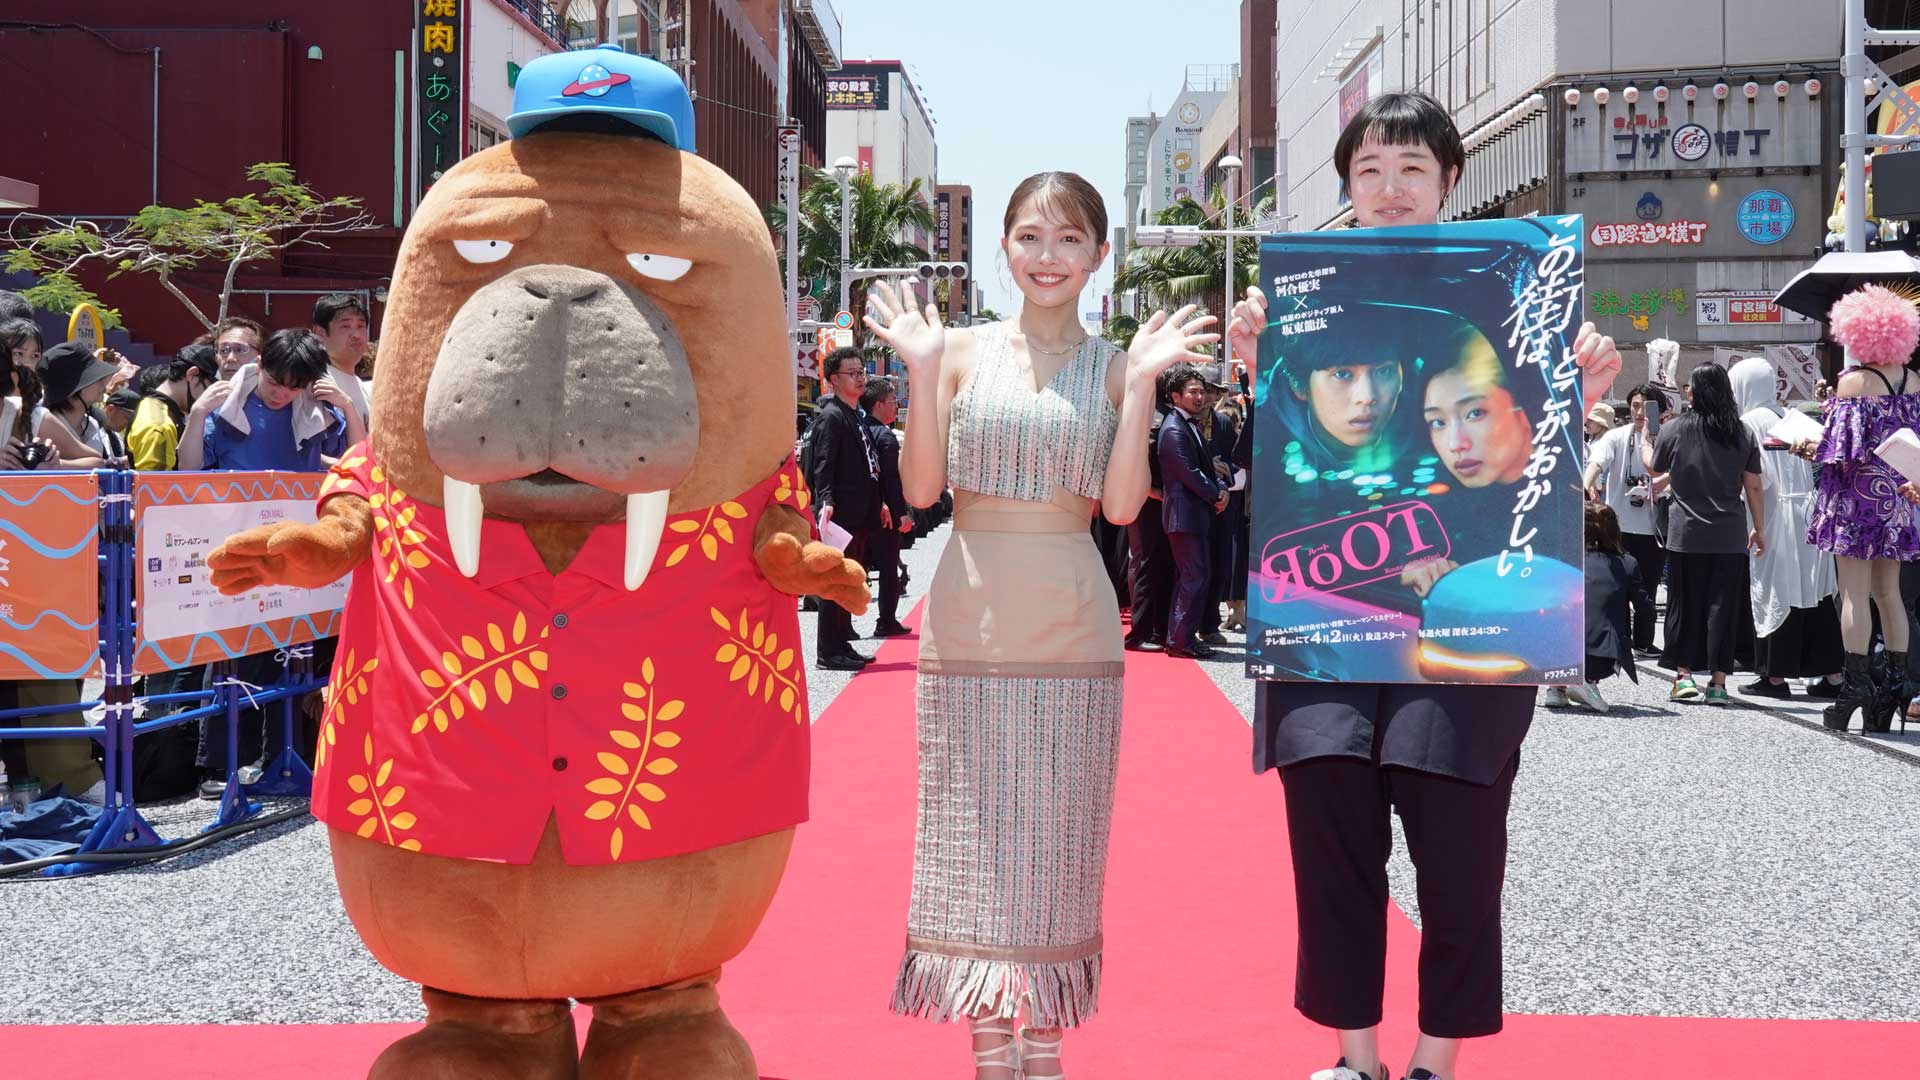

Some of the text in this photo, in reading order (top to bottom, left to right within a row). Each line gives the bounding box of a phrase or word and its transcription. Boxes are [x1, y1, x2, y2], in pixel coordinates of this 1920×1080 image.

[826, 81, 870, 92] 安の殿堂
[1573, 118, 1586, 127] 2F
[1613, 129, 1771, 160] コザ 横丁
[1573, 188, 1586, 198] 1F
[1750, 199, 1781, 213] 那覇
[1590, 221, 1707, 246] 国際通り横丁
[1750, 221, 1781, 236] 市場
[1275, 279, 1321, 298] 河合優実
[1281, 317, 1328, 336] 坂東龍汰
[1250, 665, 1275, 675] テレ東
